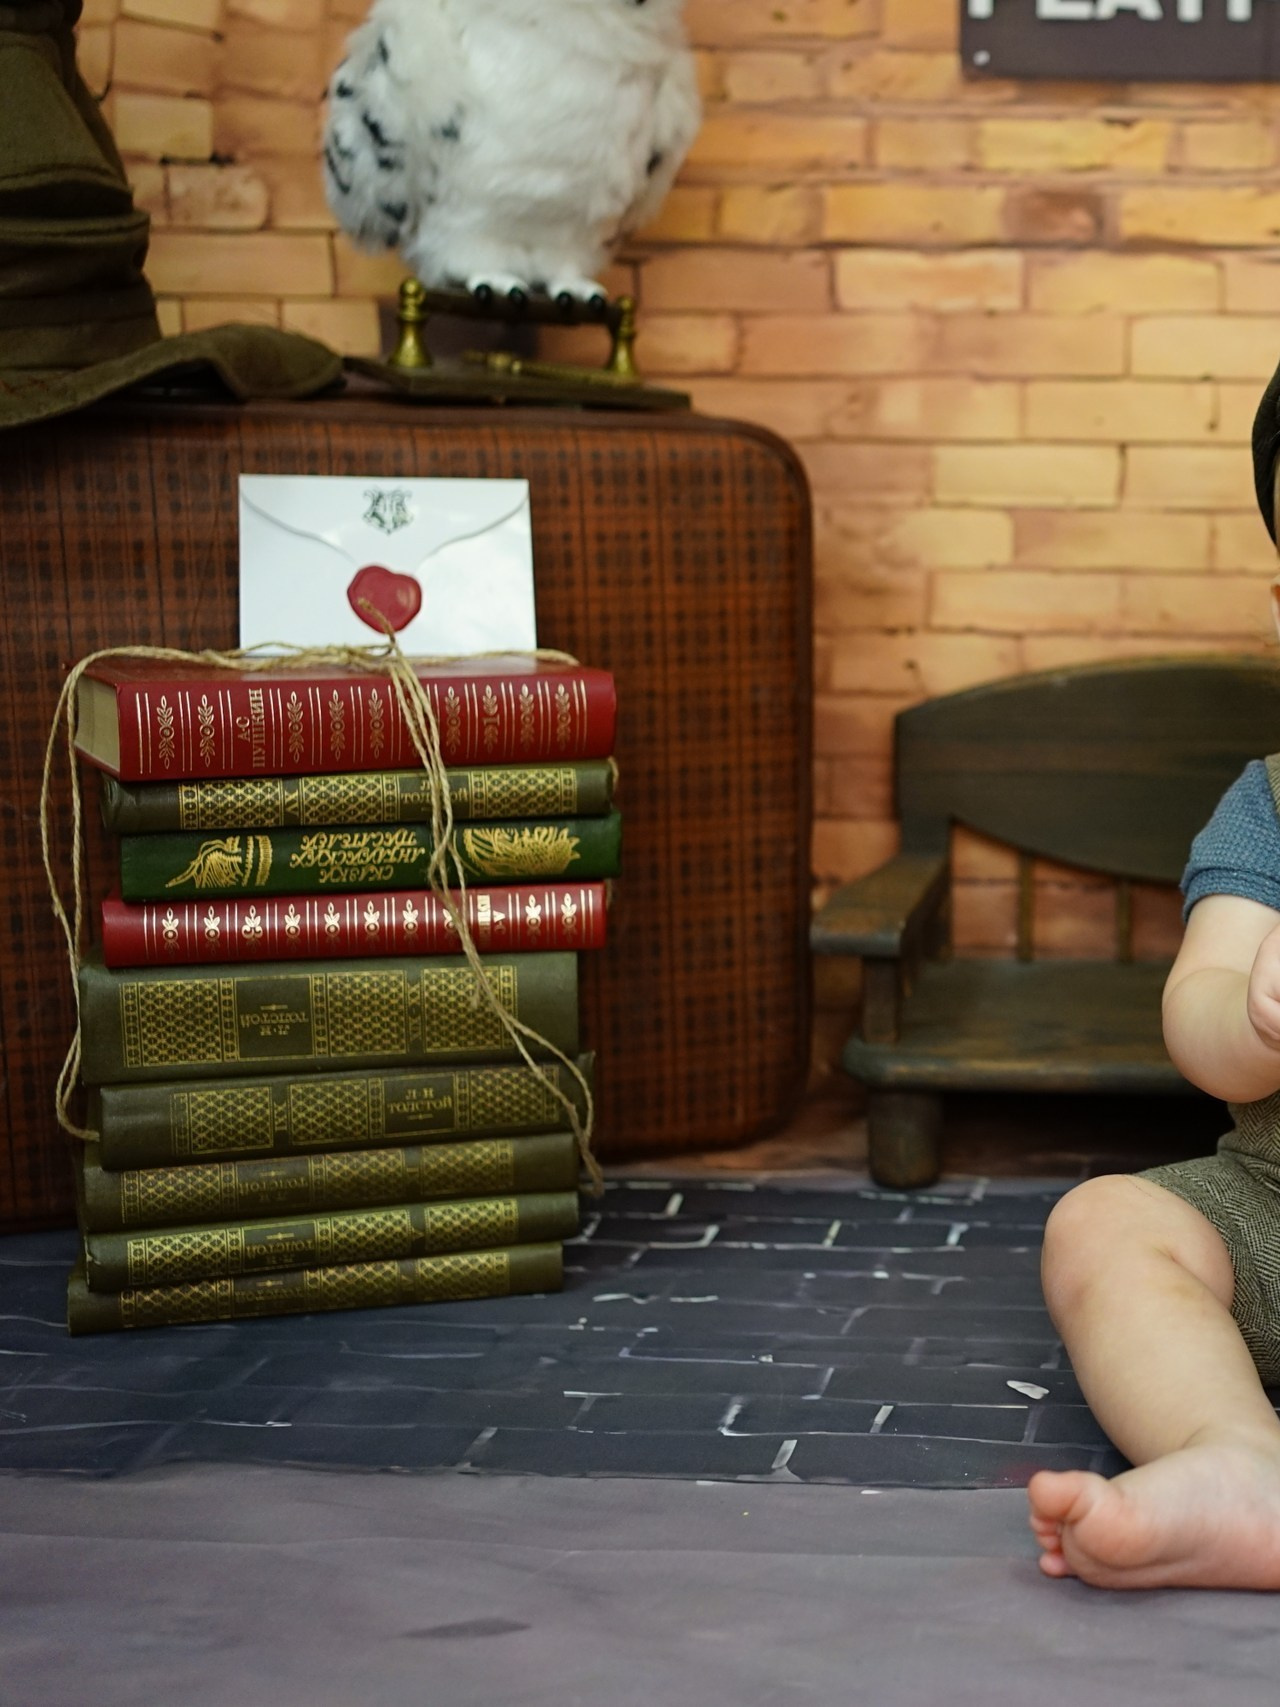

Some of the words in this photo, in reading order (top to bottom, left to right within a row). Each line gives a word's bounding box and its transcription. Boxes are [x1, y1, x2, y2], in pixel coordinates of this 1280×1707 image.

[248, 688, 266, 769] ПУШКИН
[400, 787, 468, 804] ТОЛОЙ
[300, 827, 417, 850] ПИСАТЕЛЕЙ
[289, 846, 426, 869] АНГЛИЙСКИХ
[319, 864, 394, 884] СКАЗКИ
[240, 1011, 309, 1029] ТОЛСТОЙ
[387, 1095, 453, 1114] ТОЛСТОЙ
[239, 1177, 308, 1197] ТОЛСТОЙ
[246, 1239, 315, 1260] ТОЛСТОЙ
